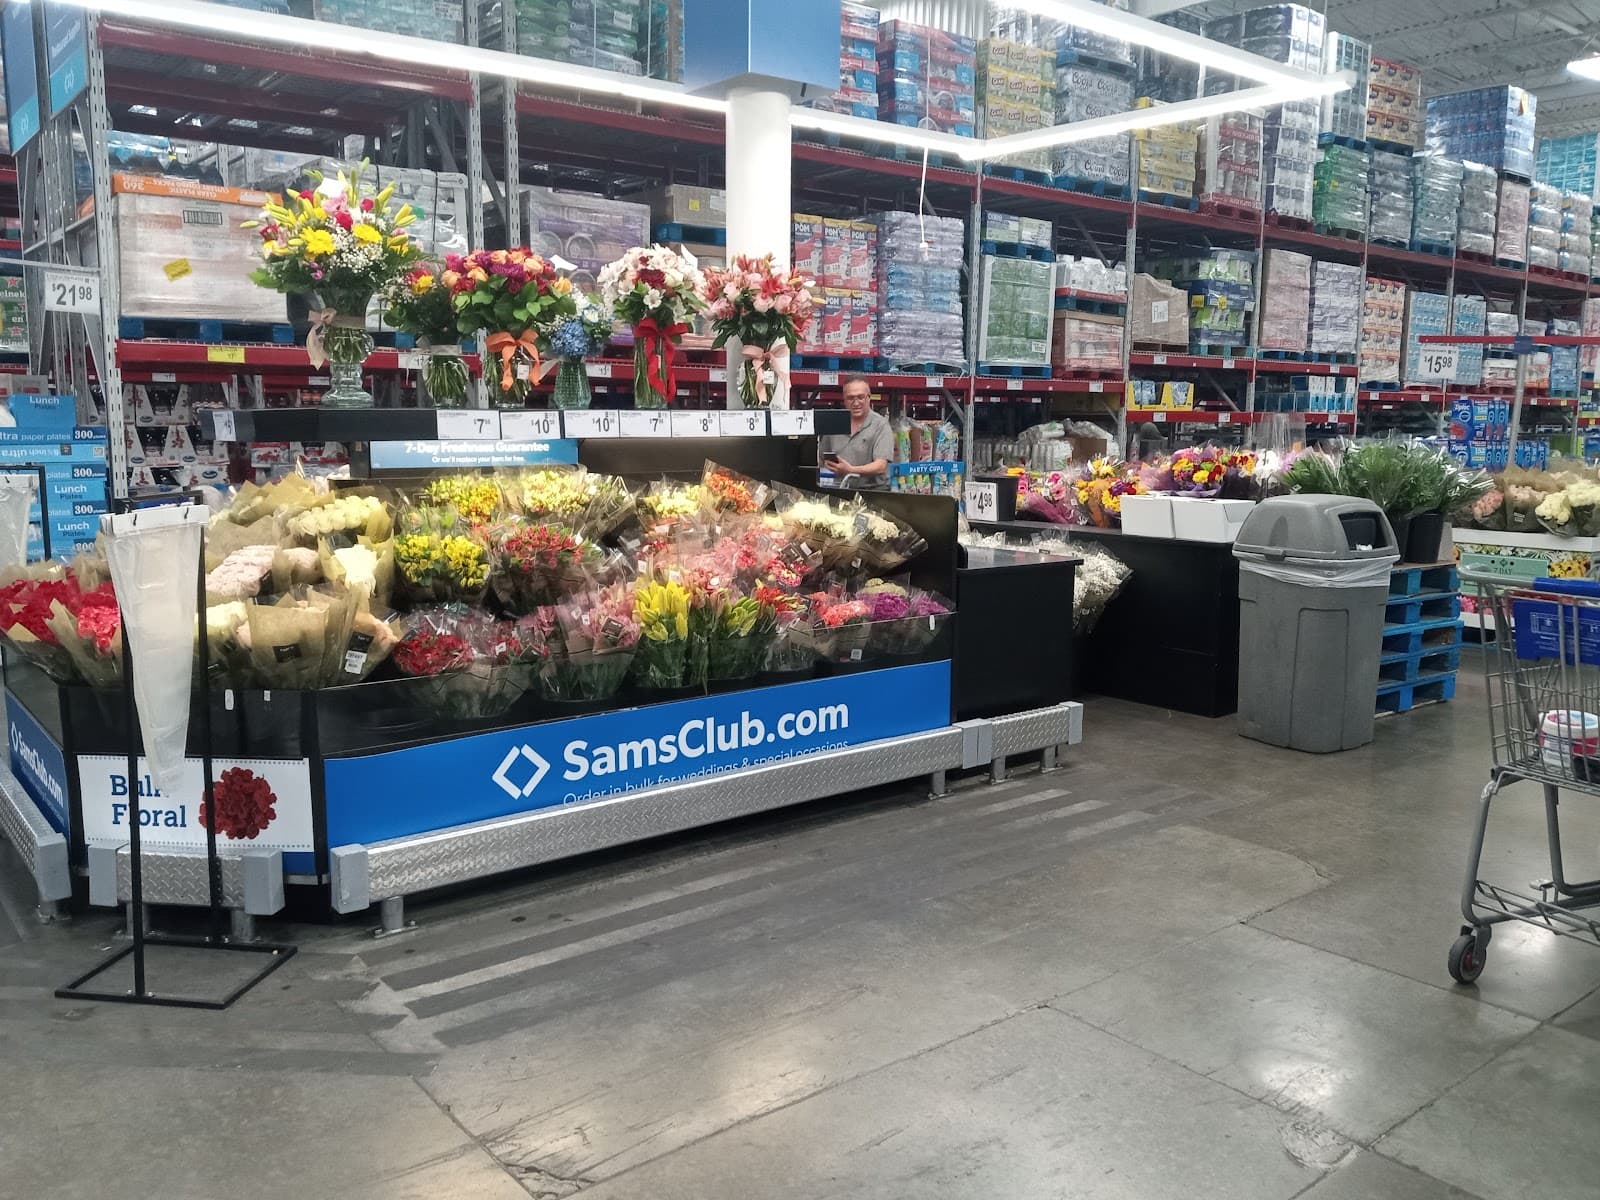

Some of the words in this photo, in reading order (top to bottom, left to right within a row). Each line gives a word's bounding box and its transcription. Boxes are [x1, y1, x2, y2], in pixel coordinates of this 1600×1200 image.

[795, 223, 810, 233] POM
[29, 395, 60, 405] Lunch
[0, 431, 19, 441] ltra
[74, 430, 94, 439] 300
[404, 442, 438, 457] 7-Day
[495, 441, 550, 452] Guarantee
[73, 468, 93, 478] 300
[54, 485, 88, 494] Lunch
[74, 505, 94, 515] 300
[57, 522, 90, 531] Lunch
[563, 703, 849, 781] SamsClub.com
[112, 803, 187, 828] Foral
